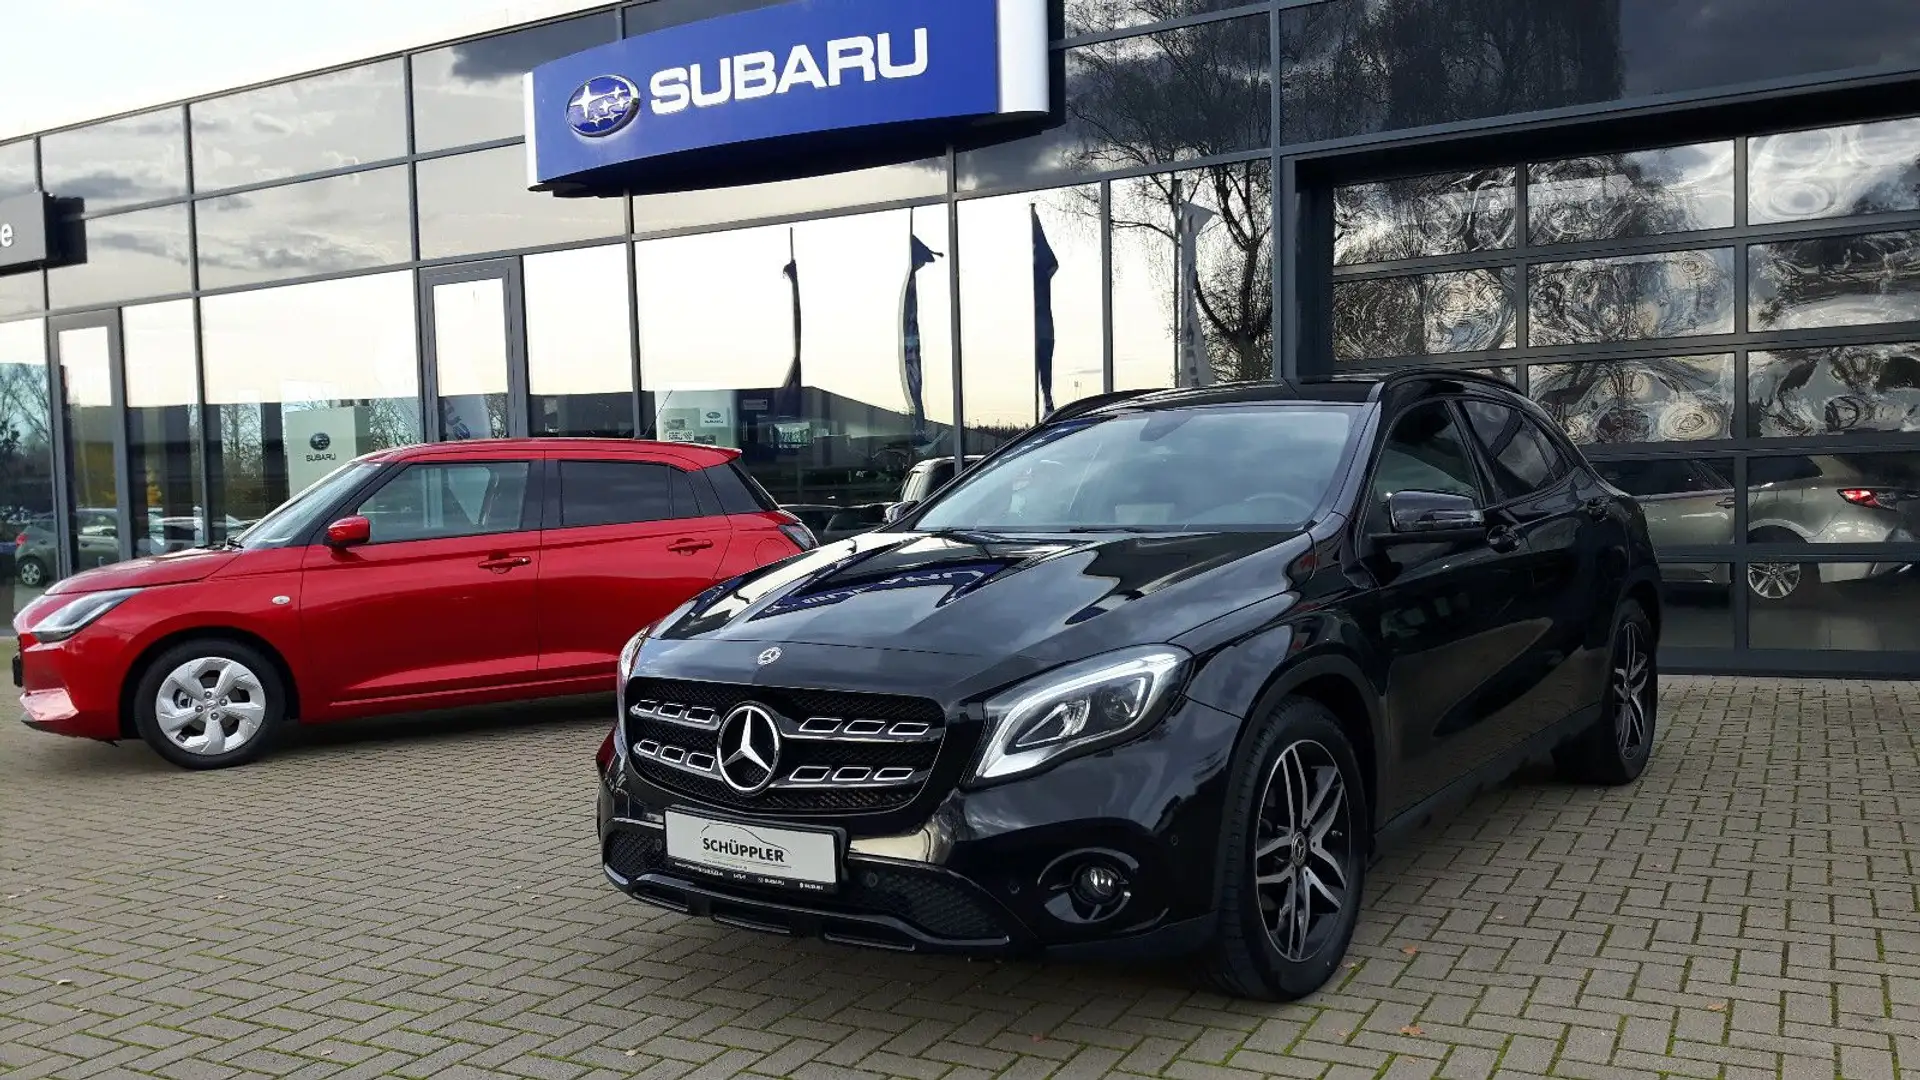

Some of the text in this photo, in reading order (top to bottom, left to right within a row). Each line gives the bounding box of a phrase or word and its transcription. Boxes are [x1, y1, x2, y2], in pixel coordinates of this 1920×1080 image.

[650, 27, 928, 115] SUBARU
[306, 453, 337, 462] SUBARU
[702, 837, 785, 863] SCHÜPPLER
